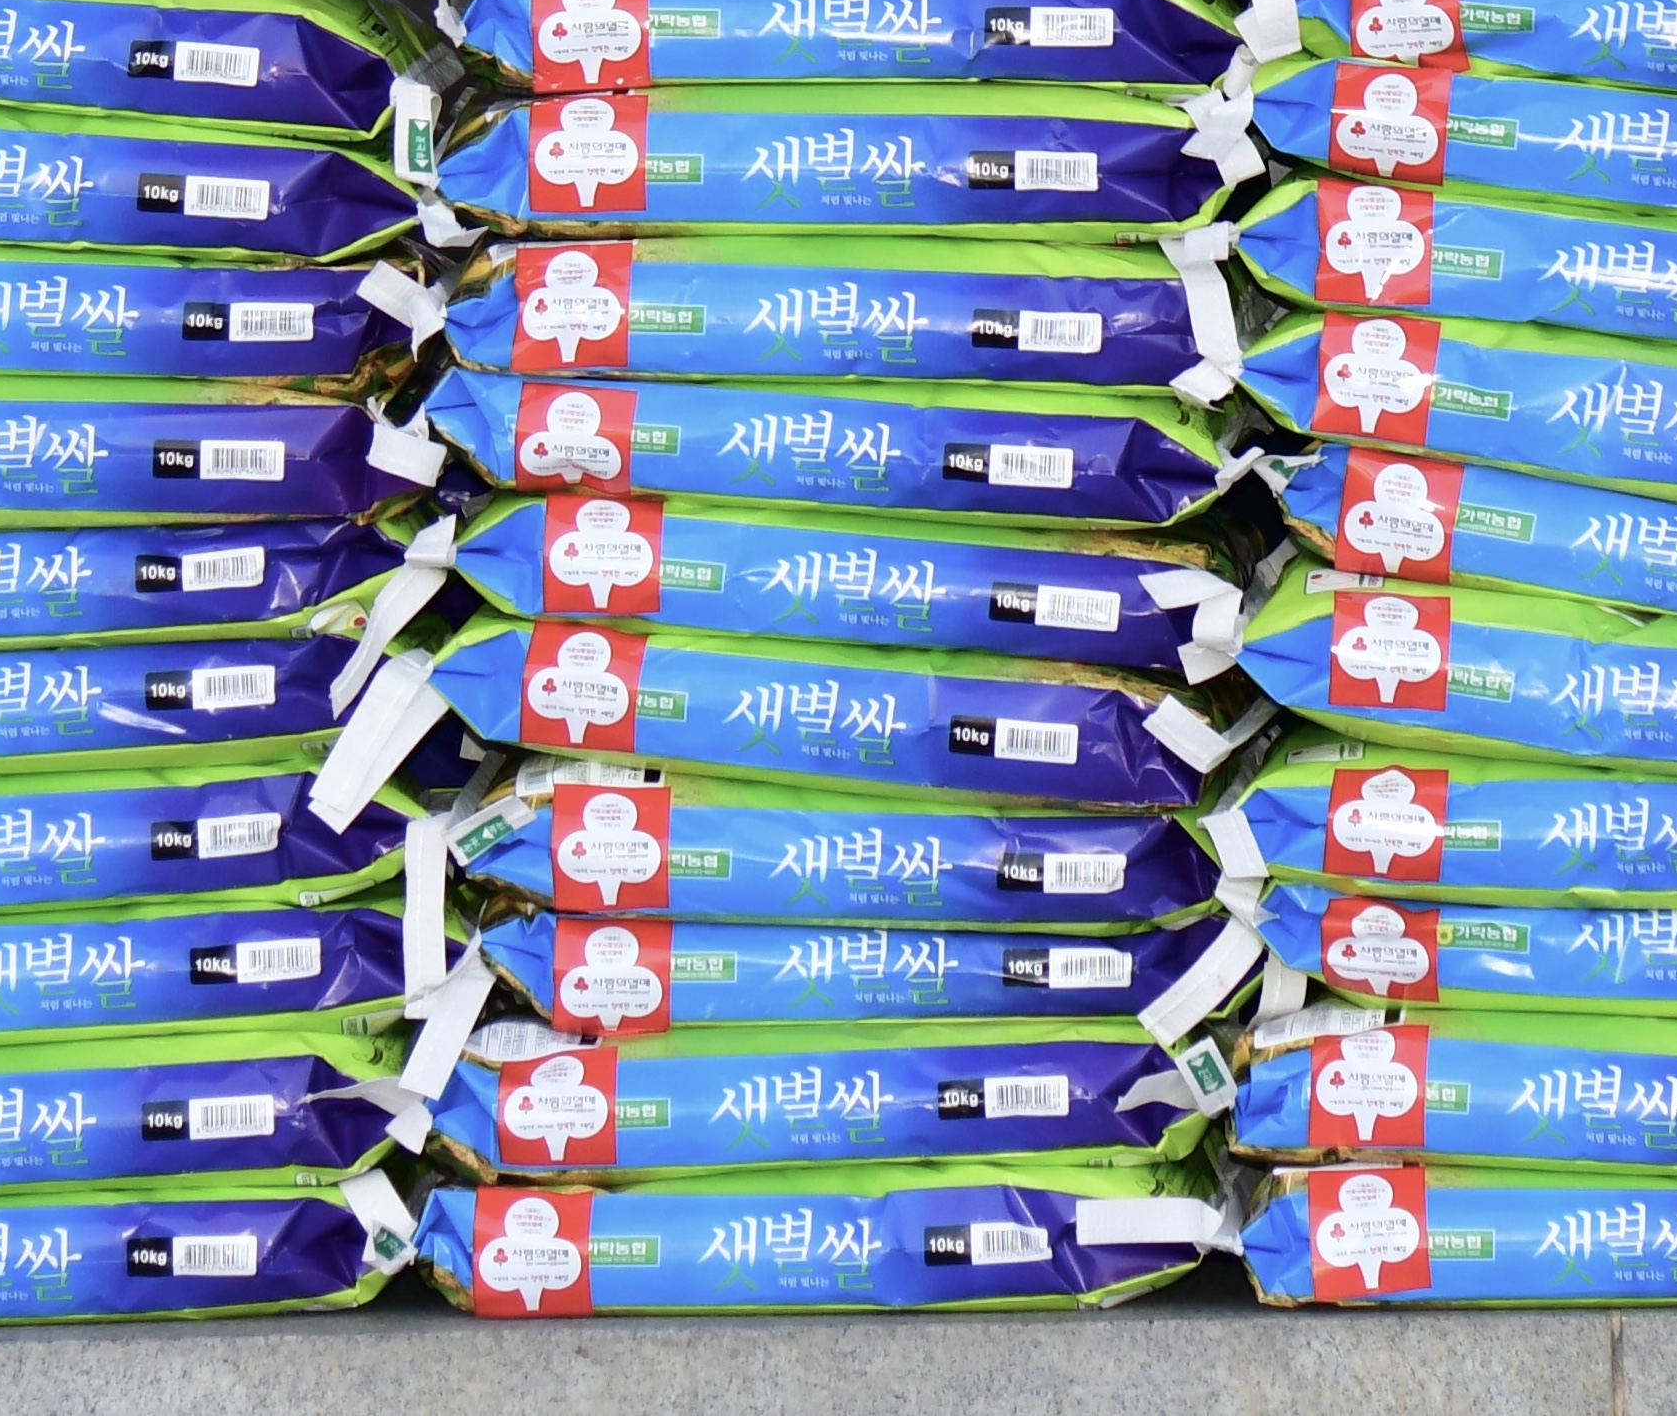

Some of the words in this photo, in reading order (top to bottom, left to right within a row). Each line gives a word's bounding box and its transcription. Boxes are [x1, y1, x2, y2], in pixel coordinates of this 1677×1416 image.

[989, 16, 1024, 34] 10kg
[953, 726, 989, 746] 10kg
[195, 955, 231, 973] 10kg
[146, 1112, 184, 1131] 10kg
